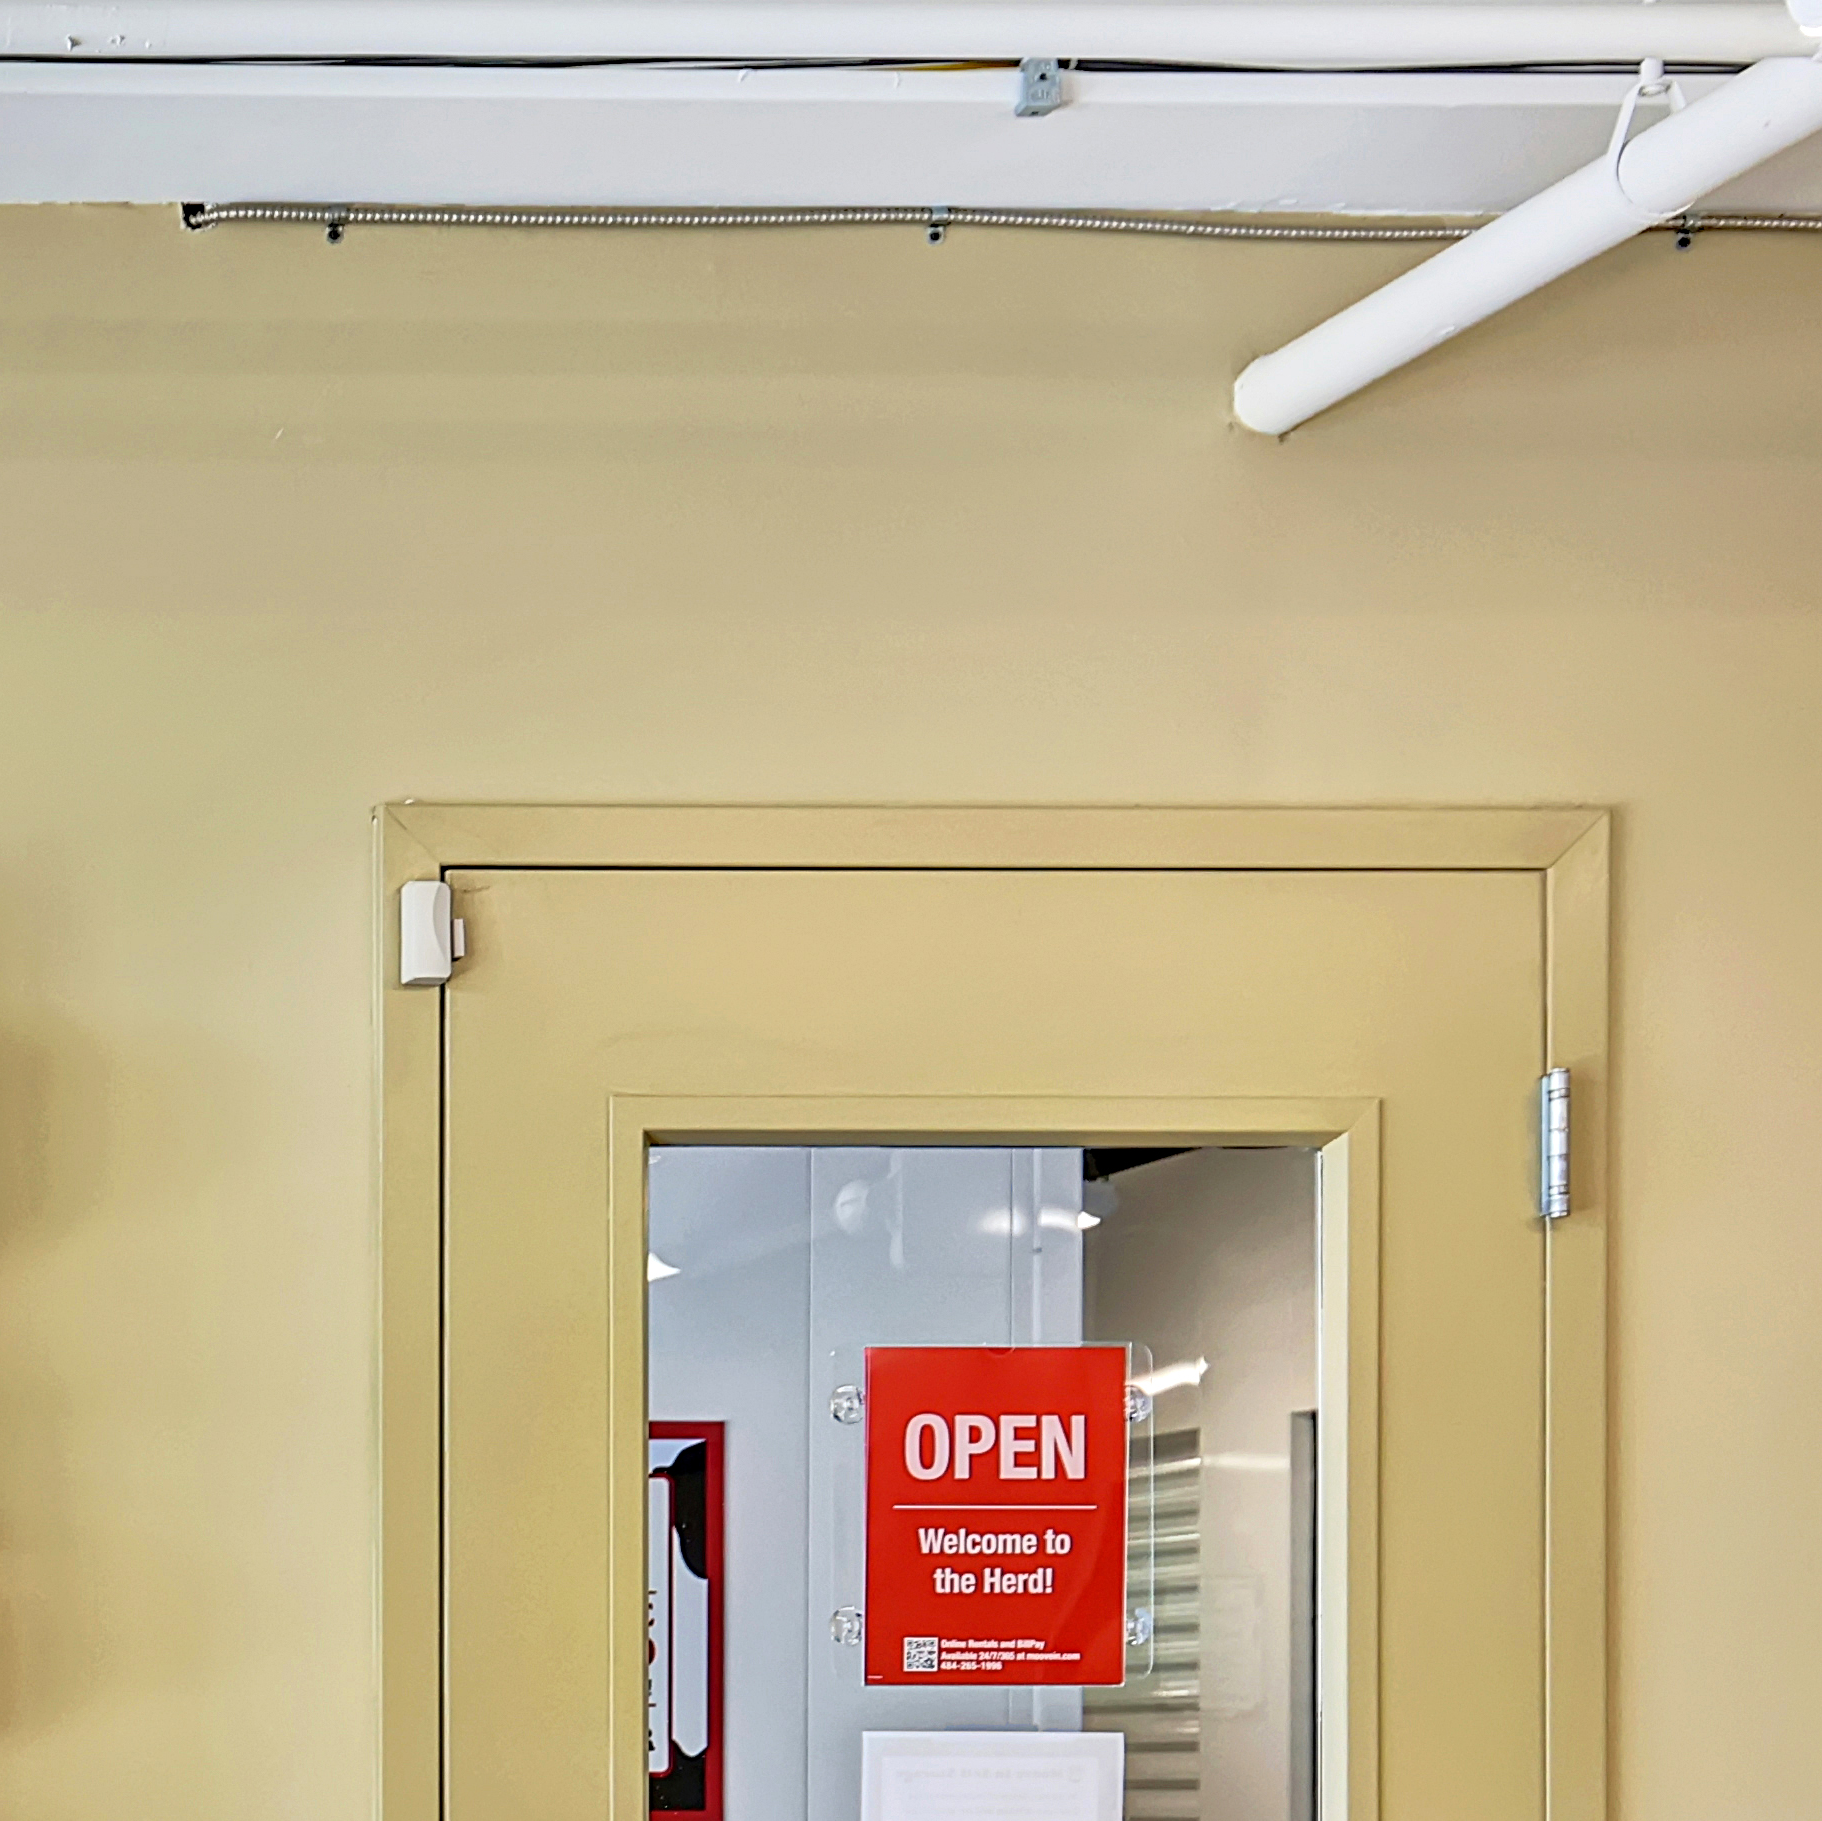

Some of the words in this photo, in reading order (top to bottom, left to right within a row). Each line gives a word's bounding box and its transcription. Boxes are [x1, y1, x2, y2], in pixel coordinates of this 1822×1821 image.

[906, 1414, 1084, 1480] OPEN
[919, 1529, 1037, 1554] Welcome
[1044, 1529, 1070, 1554] to
[934, 1568, 975, 1593] the
[984, 1568, 1052, 1593] Herd!
